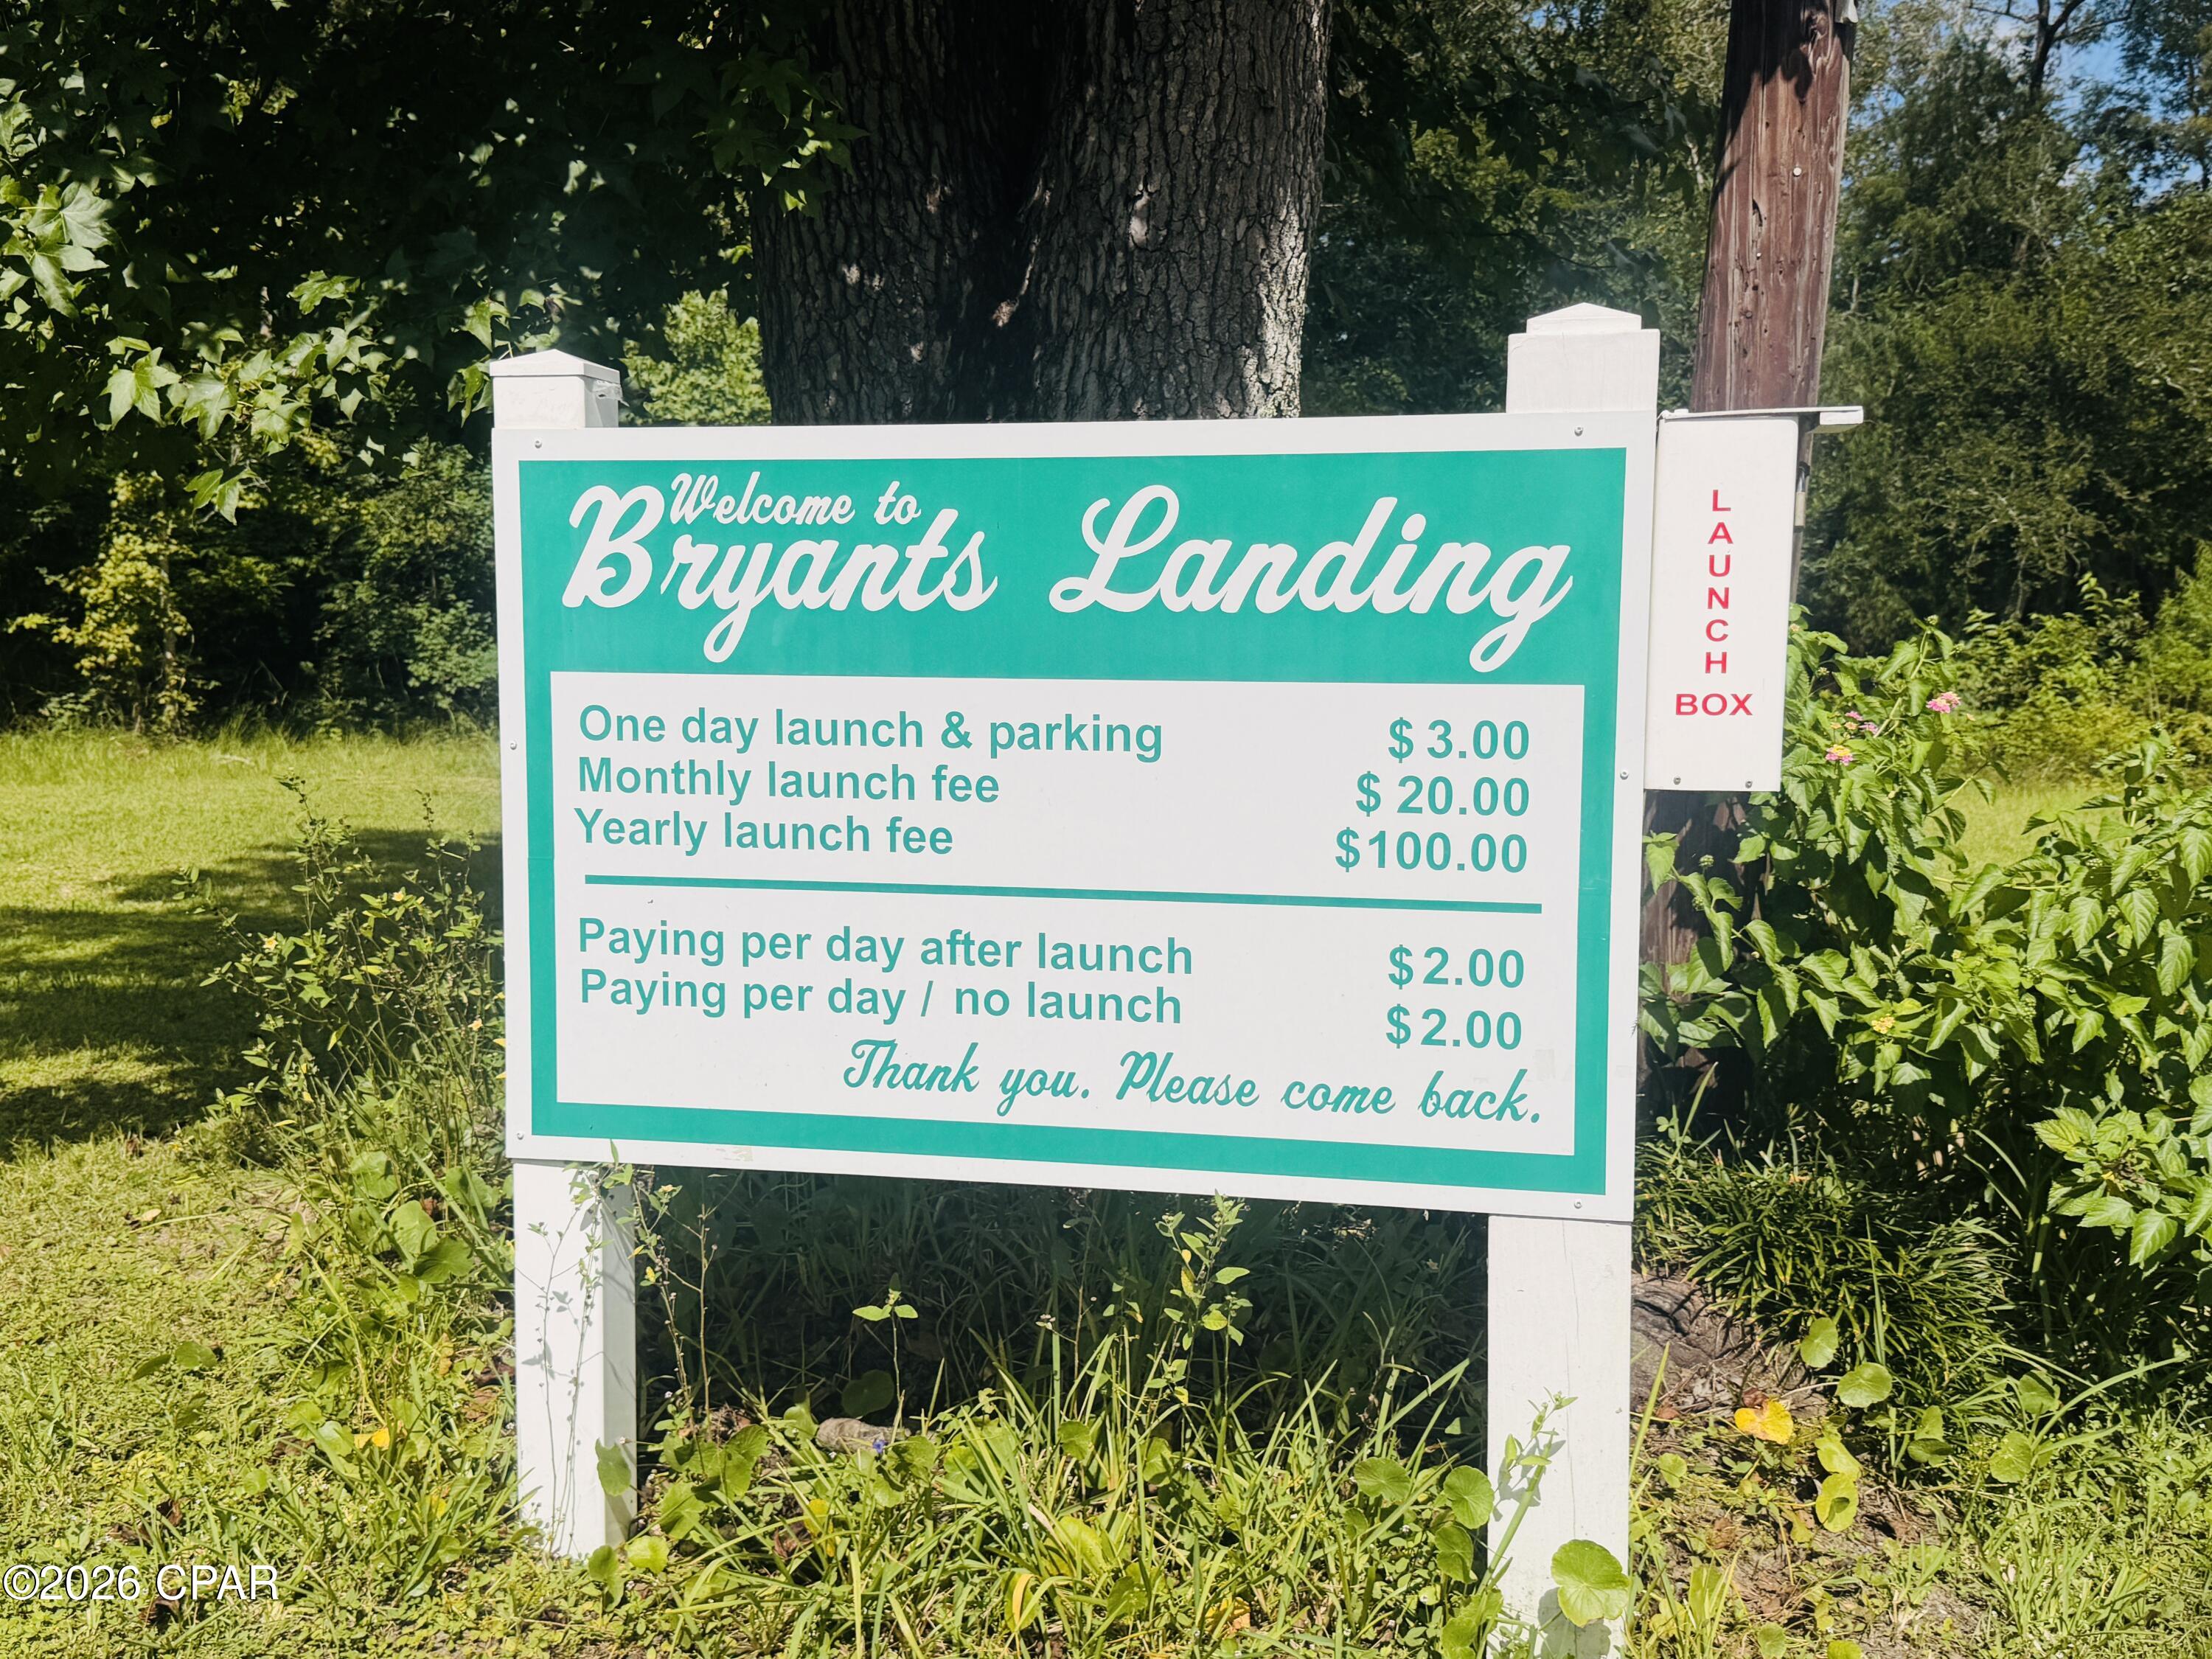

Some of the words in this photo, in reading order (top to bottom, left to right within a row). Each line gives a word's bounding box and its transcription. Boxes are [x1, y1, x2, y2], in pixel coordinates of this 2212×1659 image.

[669, 471, 855, 526] Welcome
[874, 480, 922, 526] to
[562, 484, 998, 664] Bryants
[1048, 484, 1573, 672] Landing
[1705, 490, 1733, 674] LAUNCH
[1675, 693, 1753, 717] BOX
[580, 705, 665, 742] One
[682, 708, 758, 754] day
[776, 709, 923, 748] launch
[941, 712, 973, 749] &
[990, 714, 1162, 764] parking
[579, 757, 751, 806] Monthly
[768, 762, 915, 801] launch
[931, 765, 999, 803] fee
[574, 807, 707, 856] Yearly
[725, 813, 869, 852] launch
[886, 816, 953, 855] fee
[1336, 827, 1527, 874] $100.00
[580, 917, 724, 967] Paying
[742, 933, 812, 967] per
[827, 927, 904, 973] day
[921, 930, 1022, 967] after
[1038, 932, 1192, 974] launch
[581, 968, 726, 1019] Paying
[743, 984, 813, 1019] per
[827, 979, 905, 1025] day
[921, 981, 933, 1017] /
[956, 988, 1010, 1016] no
[1028, 981, 1180, 1023] launch
[844, 1039, 979, 1093] Thank
[997, 1068, 1090, 1116] you.
[1116, 1051, 1260, 1107] Please
[1281, 1081, 1397, 1115] come
[1418, 1069, 1540, 1123] back.
